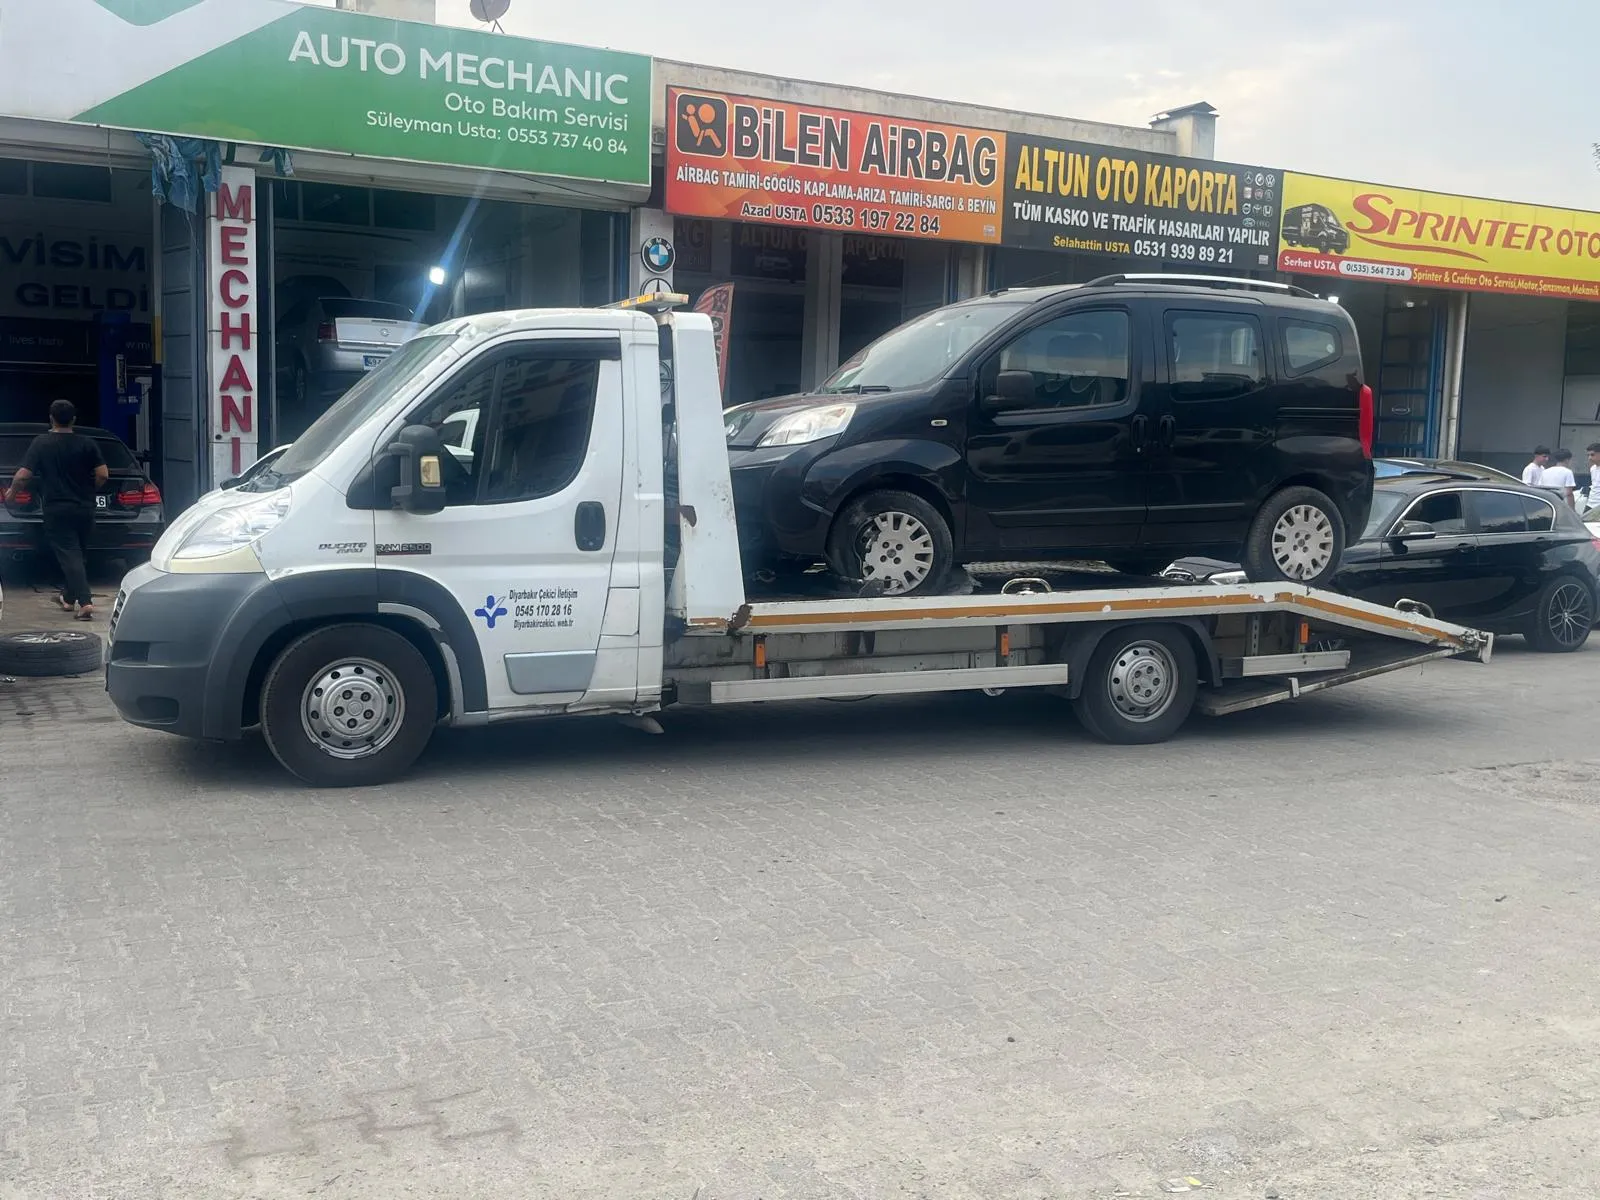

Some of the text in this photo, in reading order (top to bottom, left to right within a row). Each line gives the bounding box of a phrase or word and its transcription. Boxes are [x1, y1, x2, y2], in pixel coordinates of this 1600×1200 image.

[288, 31, 629, 105] AUTO MECHANIC
[445, 92, 628, 131] Oto Bakım Servisi
[366, 111, 628, 155] Süleyman Usta: 0553 737 40 84
[1014, 145, 1238, 216] ALTUN OTO KAPORTA
[741, 202, 941, 235] Azad USTA 0533 197 22 84
[957, 200, 965, 211] &
[967, 197, 997, 214] BEYİN
[1013, 200, 1270, 247] TÜM KASKO VE TRAFİK HASARLARI YAPILIR
[1345, 194, 1600, 259] SPRINTER OTO
[1053, 235, 1233, 264] Selahattin USTA 0531 939 89 21
[1284, 256, 1312, 268] Serhat
[1314, 261, 1337, 271] USTA
[1346, 264, 1369, 275] 0(535)
[1371, 265, 1384, 275] 564
[1386, 267, 1395, 276] 73
[1395, 267, 1405, 277] 34
[1413, 268, 1442, 283] Sprinter
[1443, 271, 1450, 283] &
[1451, 272, 1477, 285] Crafter
[1479, 274, 1492, 286] Oto
[15, 283, 149, 312] GELDİ
[318, 542, 431, 552] DUCATO RAM 2500
[515, 604, 572, 616] 0545 170 28 16
[539, 589, 556, 602] Çekici
